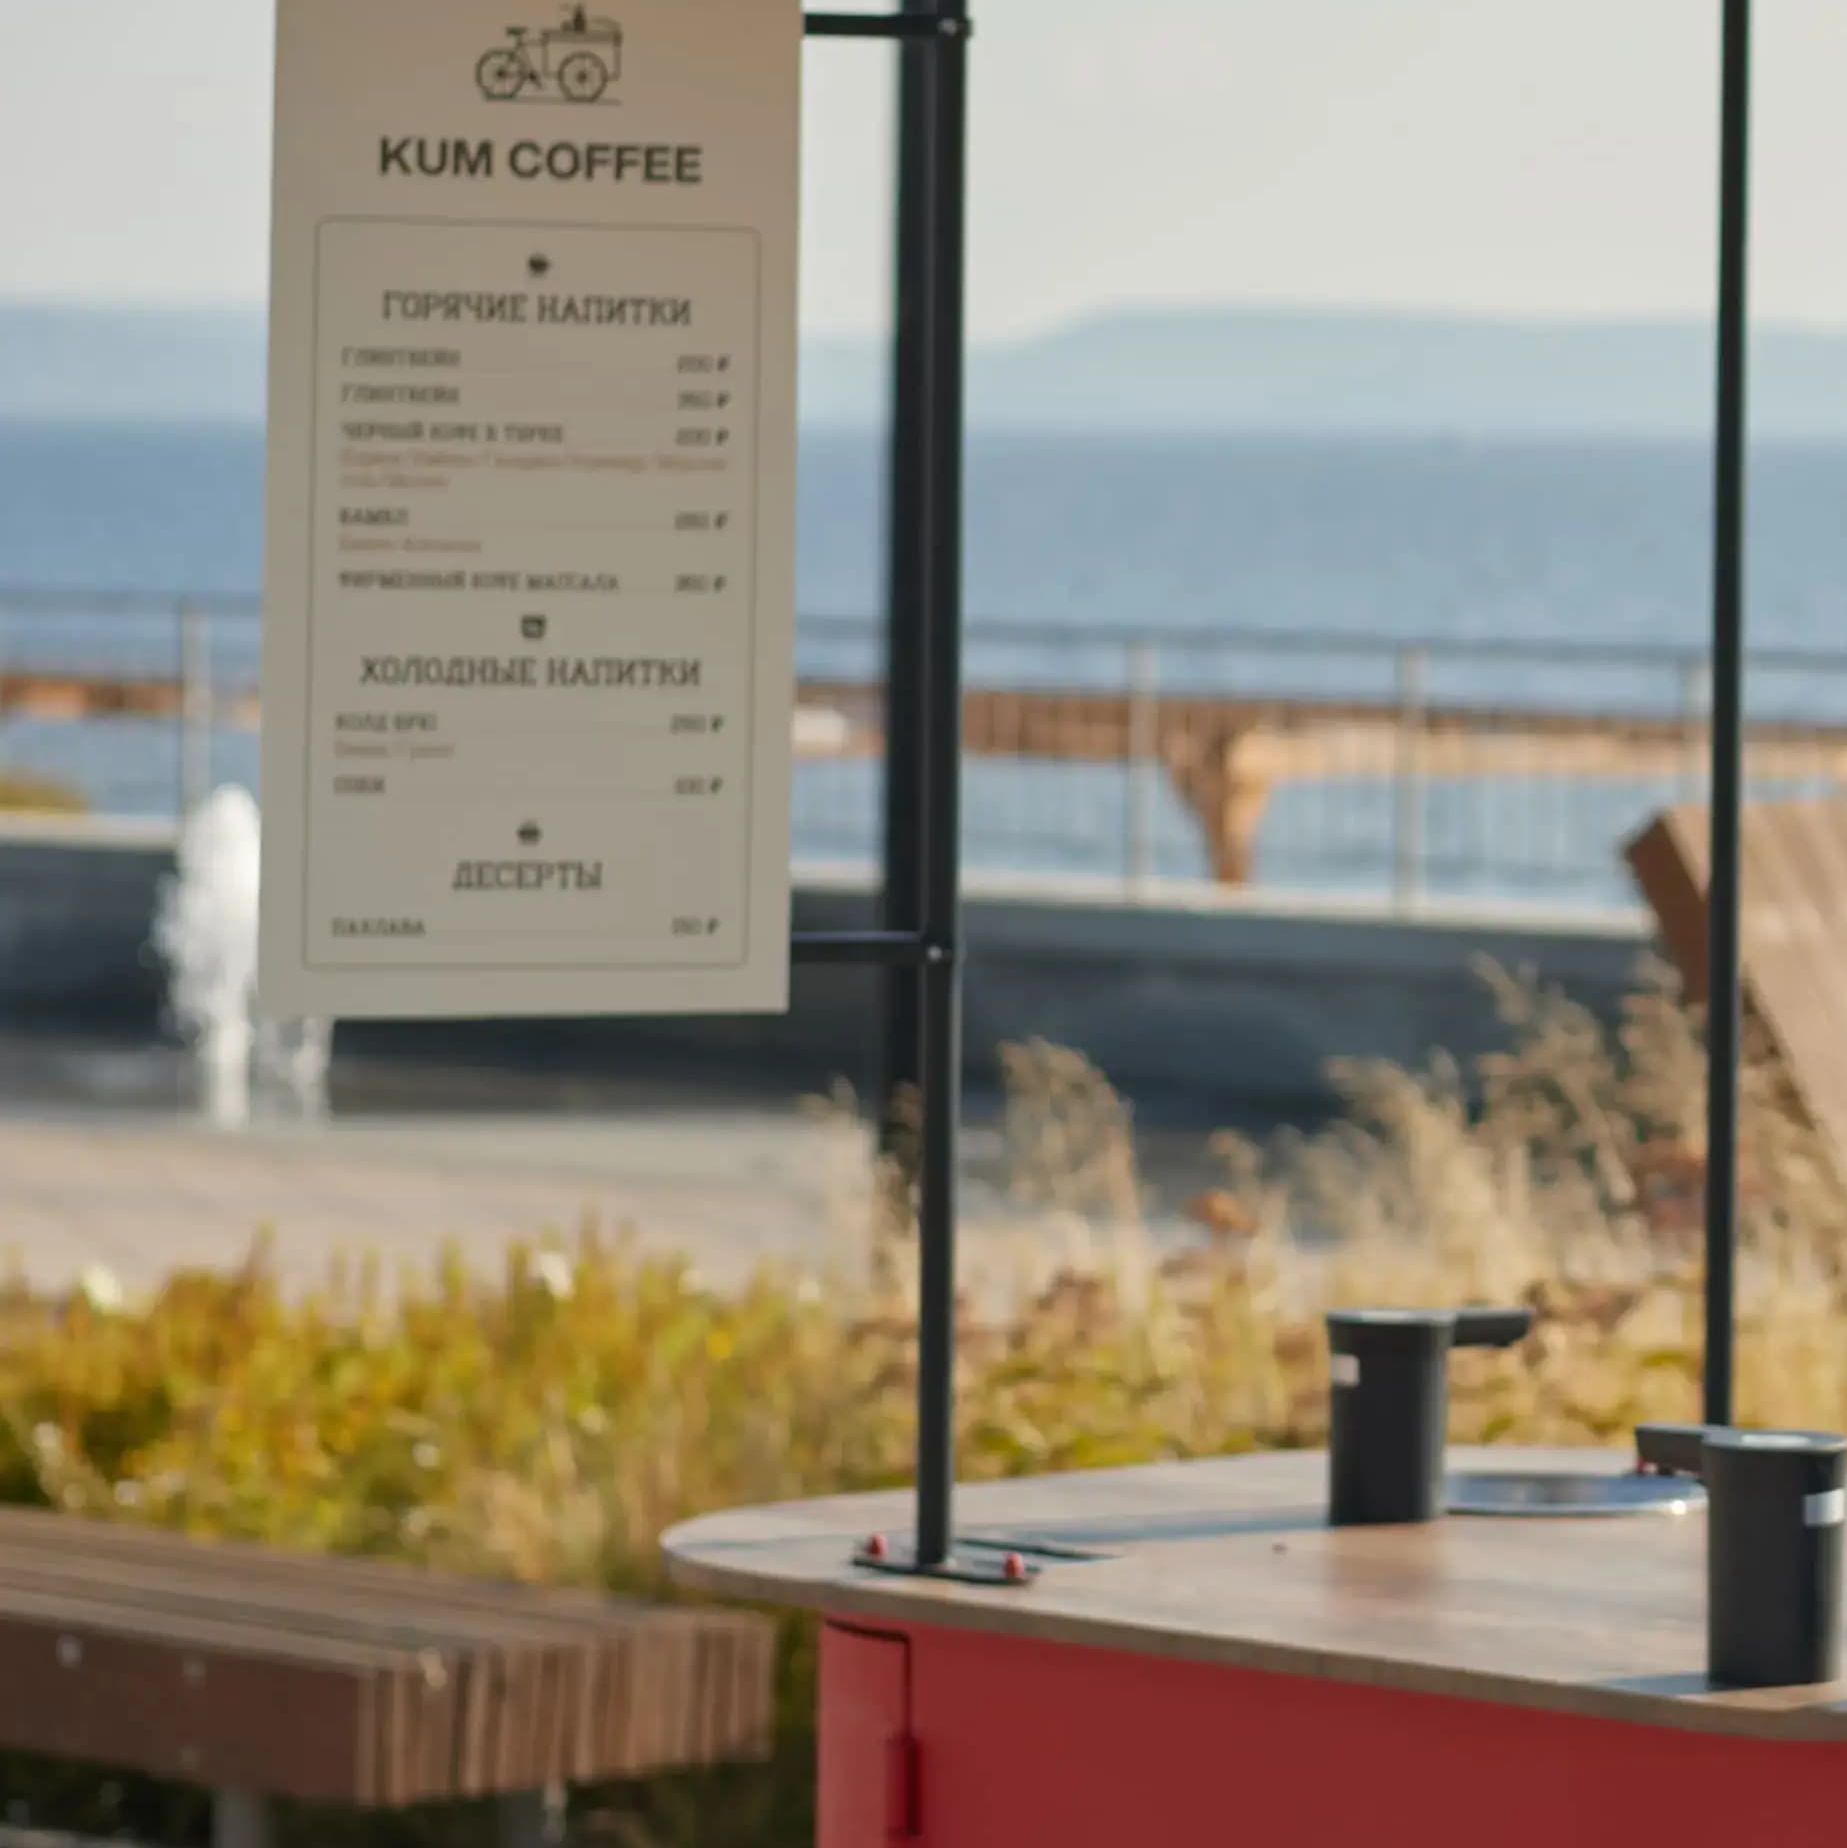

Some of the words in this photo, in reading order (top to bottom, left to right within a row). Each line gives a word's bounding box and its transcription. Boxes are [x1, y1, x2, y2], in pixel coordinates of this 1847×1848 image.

[379, 136, 494, 179] KUM
[509, 141, 703, 185] COFFEE
[382, 290, 528, 324] ГОРЯЧИЕ
[538, 294, 692, 327] НАПИТКИ
[359, 655, 537, 688] ХОЛОДНЫЕ
[547, 657, 702, 689] НАПИТКИ
[451, 860, 604, 892] ДЕСЕРТЫ
